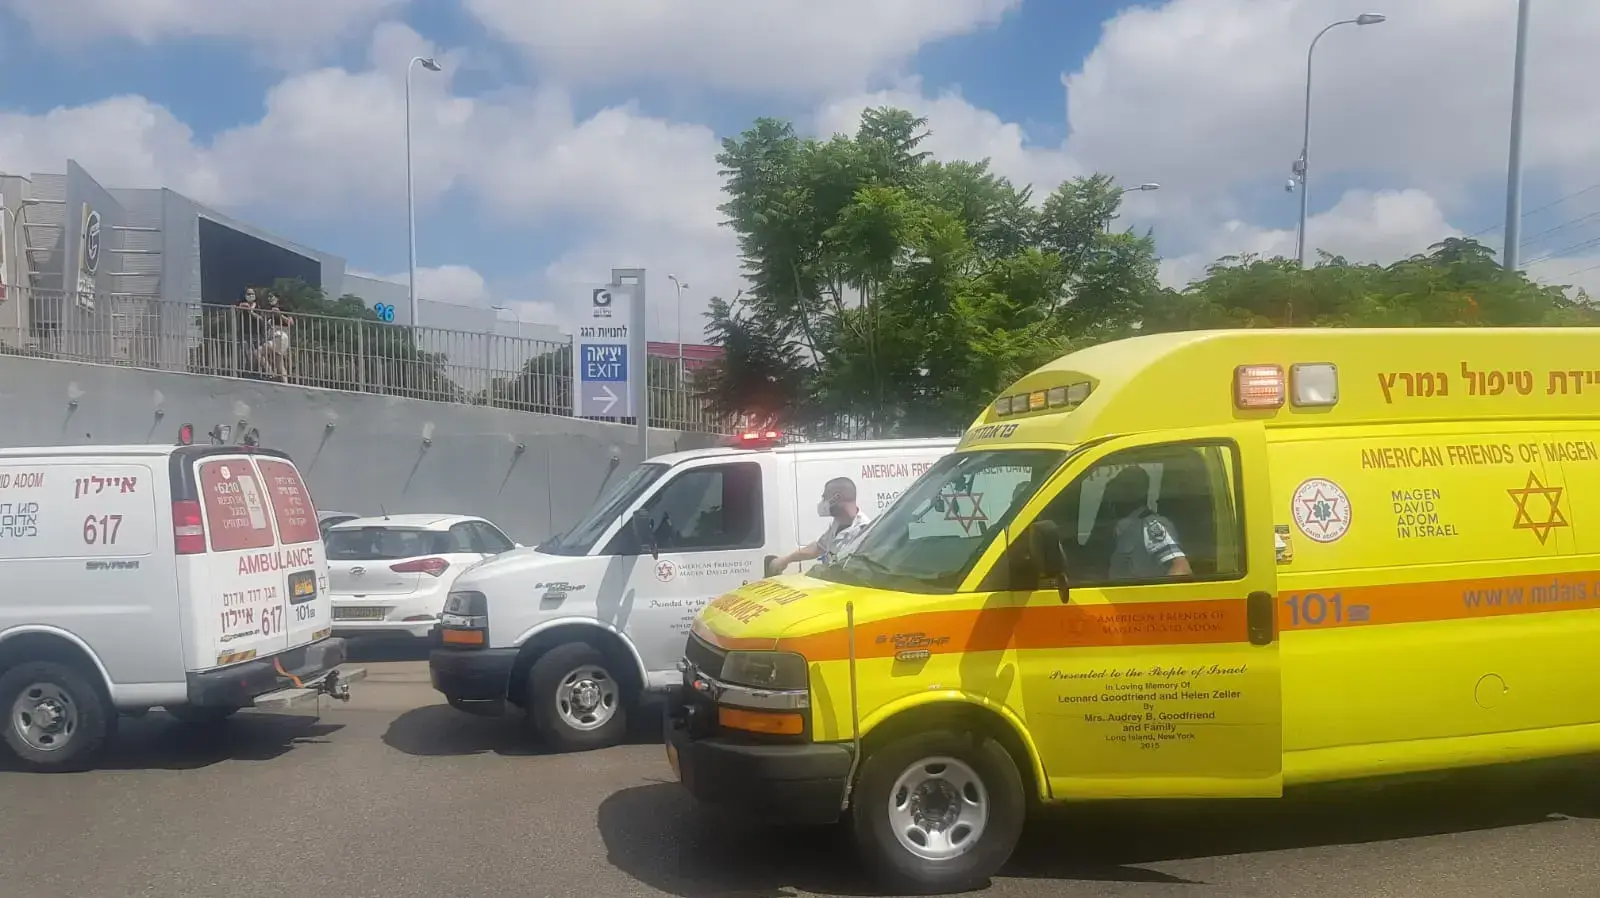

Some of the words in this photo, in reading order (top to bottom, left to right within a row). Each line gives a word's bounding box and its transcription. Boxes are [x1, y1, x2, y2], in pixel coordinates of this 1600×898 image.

[580, 327, 595, 338] הגג
[598, 324, 627, 338] לחנויות
[587, 346, 621, 362] יציאה
[588, 363, 621, 378] EXIT
[1460, 361, 1533, 396] טיפול
[1377, 371, 1449, 404] נמרץ
[1361, 446, 1444, 469] AMERICAN
[1447, 443, 1514, 466] FRIENDS
[1519, 443, 1540, 463] OF
[1543, 441, 1598, 461] MAGEN
[861, 463, 909, 479] AMERICAN
[911, 462, 933, 477] FRIE
[13, 472, 45, 488] ADOM
[75, 475, 137, 499] איילון
[1391, 488, 1441, 502] MAGEN
[1393, 501, 1435, 514] DAVID
[2, 514, 37, 526] אדום
[1397, 513, 1439, 526] ADOM
[83, 514, 123, 545] 617
[1397, 526, 1410, 538] IN
[1415, 524, 1459, 538] ISRAEL
[238, 548, 315, 576] AMBULANCE
[678, 562, 712, 570] AMERICAN
[714, 561, 742, 569] FRIENDS
[223, 591, 244, 607] אדום
[247, 589, 261, 603] דוד
[296, 604, 311, 622] 101
[1284, 592, 1343, 625] 101
[220, 608, 254, 633] איילון
[261, 605, 283, 636] 617
[1096, 613, 1156, 623] AMERICAN
[1160, 611, 1208, 621] FRIENDS
[1147, 623, 1184, 633] DAVID
[1049, 668, 1107, 680] Presented
[1110, 668, 1121, 678] to
[1126, 668, 1143, 677] the
[1148, 666, 1187, 680] People
[1191, 665, 1205, 679] of
[1207, 663, 1248, 677] Israel
[1115, 682, 1143, 692] Loving
[1145, 682, 1178, 690] Memory
[1058, 694, 1098, 703] Leonard
[1101, 692, 1157, 702] Goodfriend
[1159, 691, 1178, 700] and
[1181, 691, 1209, 699] Helen
[1212, 689, 1241, 699] Zeller
[1143, 703, 1154, 711] By
[1084, 713, 1105, 722] Mrs.
[1108, 712, 1143, 722] Audrey
[1145, 712, 1156, 721] B.
[1158, 710, 1215, 720] Goodfriend
[1122, 723, 1141, 732] and
[1144, 722, 1176, 733] Family
[1105, 734, 1126, 742] Long
[1128, 733, 1156, 741] Island,
[1176, 732, 1195, 740] York
